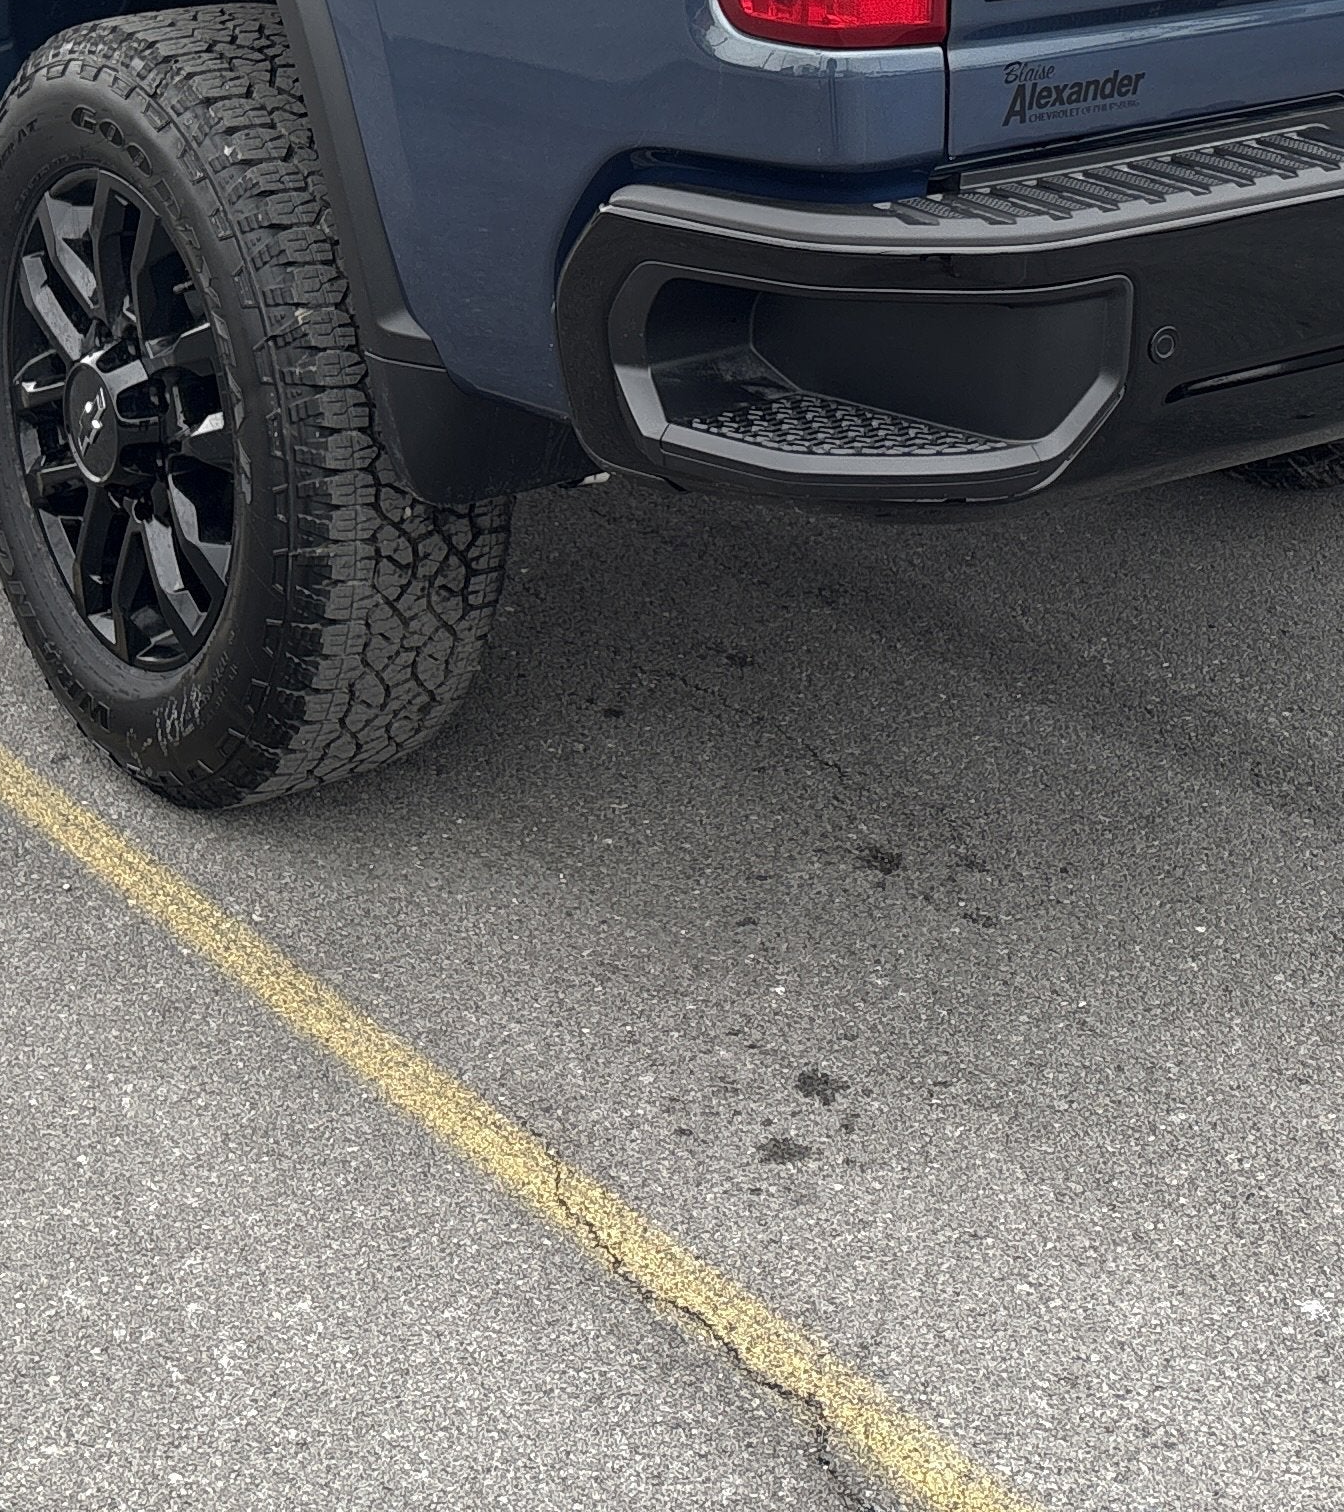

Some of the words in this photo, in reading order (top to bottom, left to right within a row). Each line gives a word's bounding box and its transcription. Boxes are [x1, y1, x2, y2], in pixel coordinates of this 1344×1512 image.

[1003, 60, 1056, 84] Blaise
[1002, 69, 1146, 126] Alexander
[1028, 108, 1080, 123] CHEVROLET
[71, 104, 254, 505] GOODYEAR
